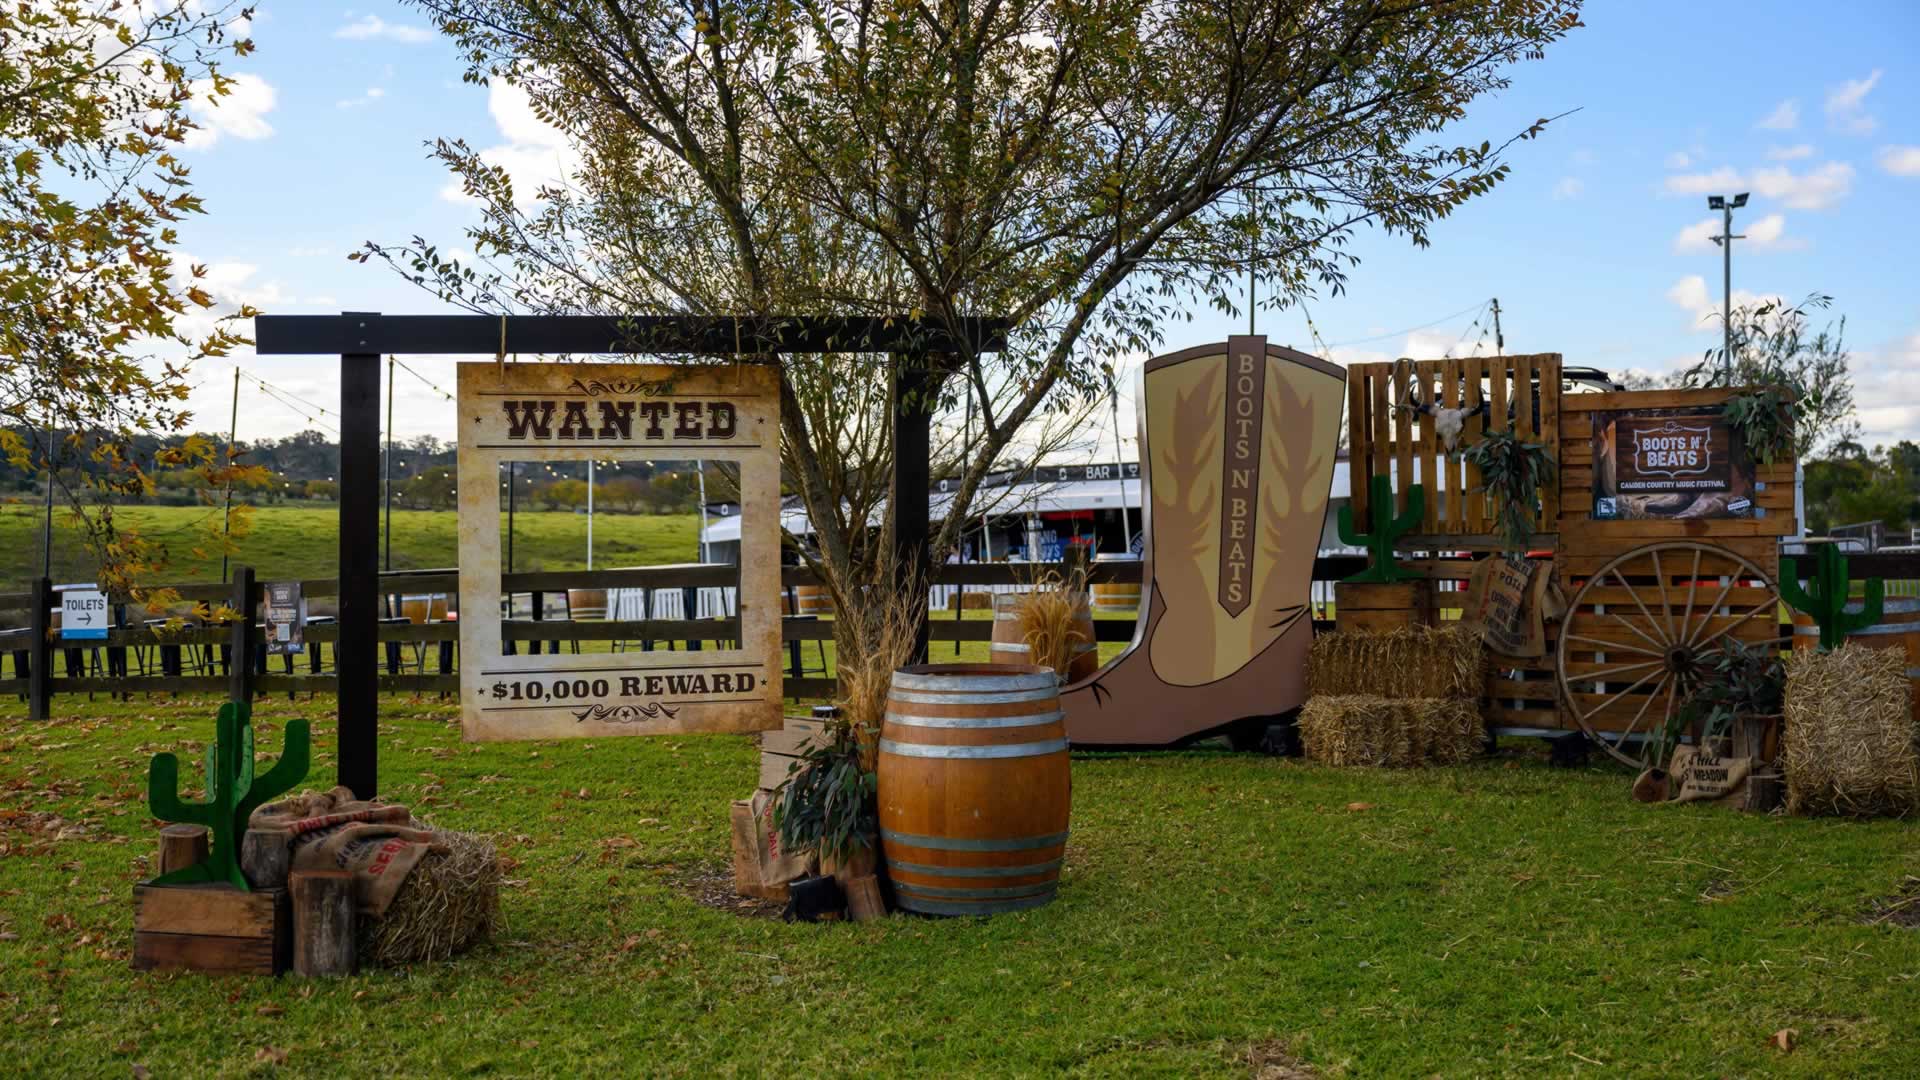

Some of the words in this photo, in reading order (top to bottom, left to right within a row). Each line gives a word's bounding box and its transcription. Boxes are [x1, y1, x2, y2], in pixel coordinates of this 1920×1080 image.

[1234, 354, 1255, 459] BOOTS
[503, 400, 739, 440] WANTED
[1642, 436, 1686, 451] BOOTS
[1647, 450, 1698, 467] BEATS
[1086, 465, 1110, 480] BAR
[1620, 481, 1646, 489] CAMDEN
[1646, 481, 1675, 489] COUNTRY
[1676, 480, 1696, 488] MUSIC
[1696, 479, 1726, 488] FESTIVAL
[1227, 498, 1249, 602] BEATS
[65, 599, 104, 610] TOILETS
[492, 680, 609, 702] $10,000
[619, 672, 756, 697] REWARD
